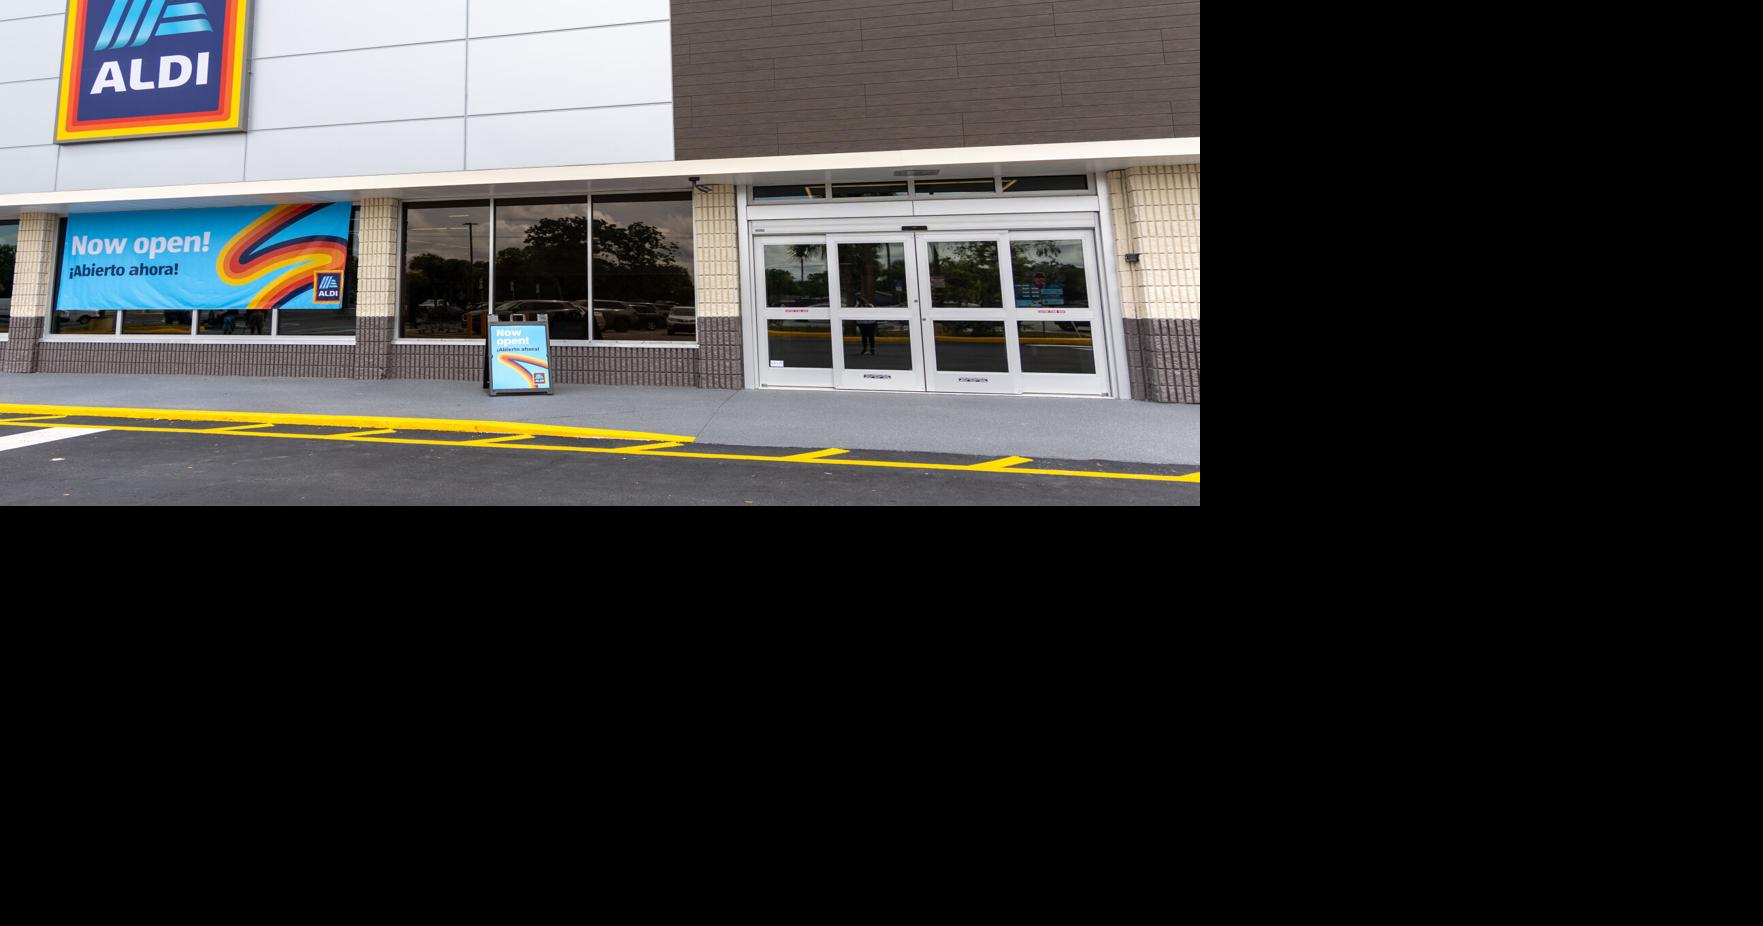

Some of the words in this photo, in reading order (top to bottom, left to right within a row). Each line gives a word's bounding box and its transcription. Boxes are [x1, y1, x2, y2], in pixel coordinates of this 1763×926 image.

[90, 51, 210, 95] ALDI
[71, 235, 128, 256] Now
[133, 231, 211, 259] open!
[69, 263, 126, 279] ¡Abierto
[129, 263, 179, 276] ahora!
[496, 328, 521, 336] Now
[496, 336, 529, 346] open!
